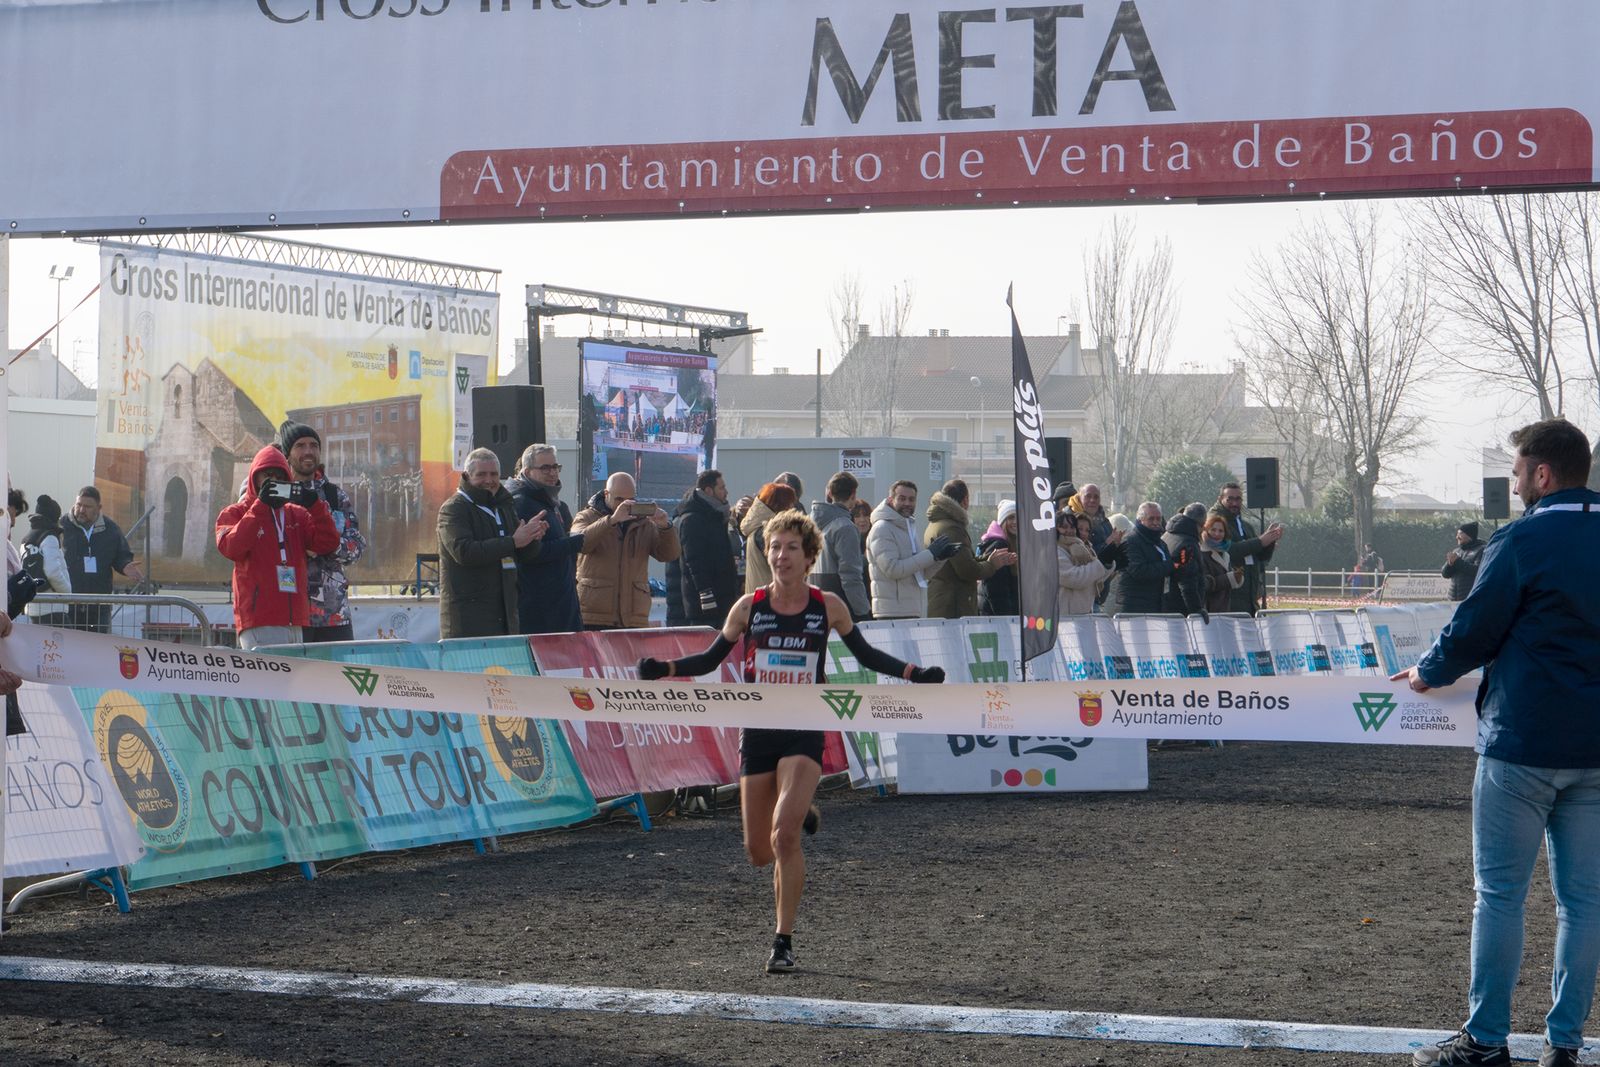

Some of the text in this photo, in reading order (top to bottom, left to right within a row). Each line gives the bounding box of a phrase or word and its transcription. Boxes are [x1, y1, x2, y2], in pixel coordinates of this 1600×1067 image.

[801, 0, 1177, 126] META
[473, 118, 1538, 207] Ayuntamiento de Venta de Baños
[110, 253, 492, 337] Cross Internacional de Venta de Baños
[1015, 379, 1056, 531] be plus
[843, 459, 872, 469] BRUN
[145, 647, 292, 673] Venta de Baños
[147, 665, 240, 684] Ayuntamiento
[387, 684, 428, 693] PORTLAND
[388, 690, 435, 699] VALDERRIVAS
[597, 687, 763, 702] Venta de Baños
[604, 701, 706, 713] Ayuntamiento
[1111, 689, 1290, 710] Venta de Baños
[872, 712, 923, 720] VALDERRIVAS
[1112, 709, 1223, 728] Ayuntamiento
[1400, 715, 1449, 723] PORTLAND
[1401, 708, 1443, 716] CEMENTOS
[1400, 723, 1456, 731] VALDERRIVAS
[7, 755, 104, 814] AÑOS
[202, 757, 384, 838] COUNTRY
[381, 746, 498, 812] TOUR
[136, 788, 160, 799] WORLD
[137, 799, 173, 812] ATHLETICS
